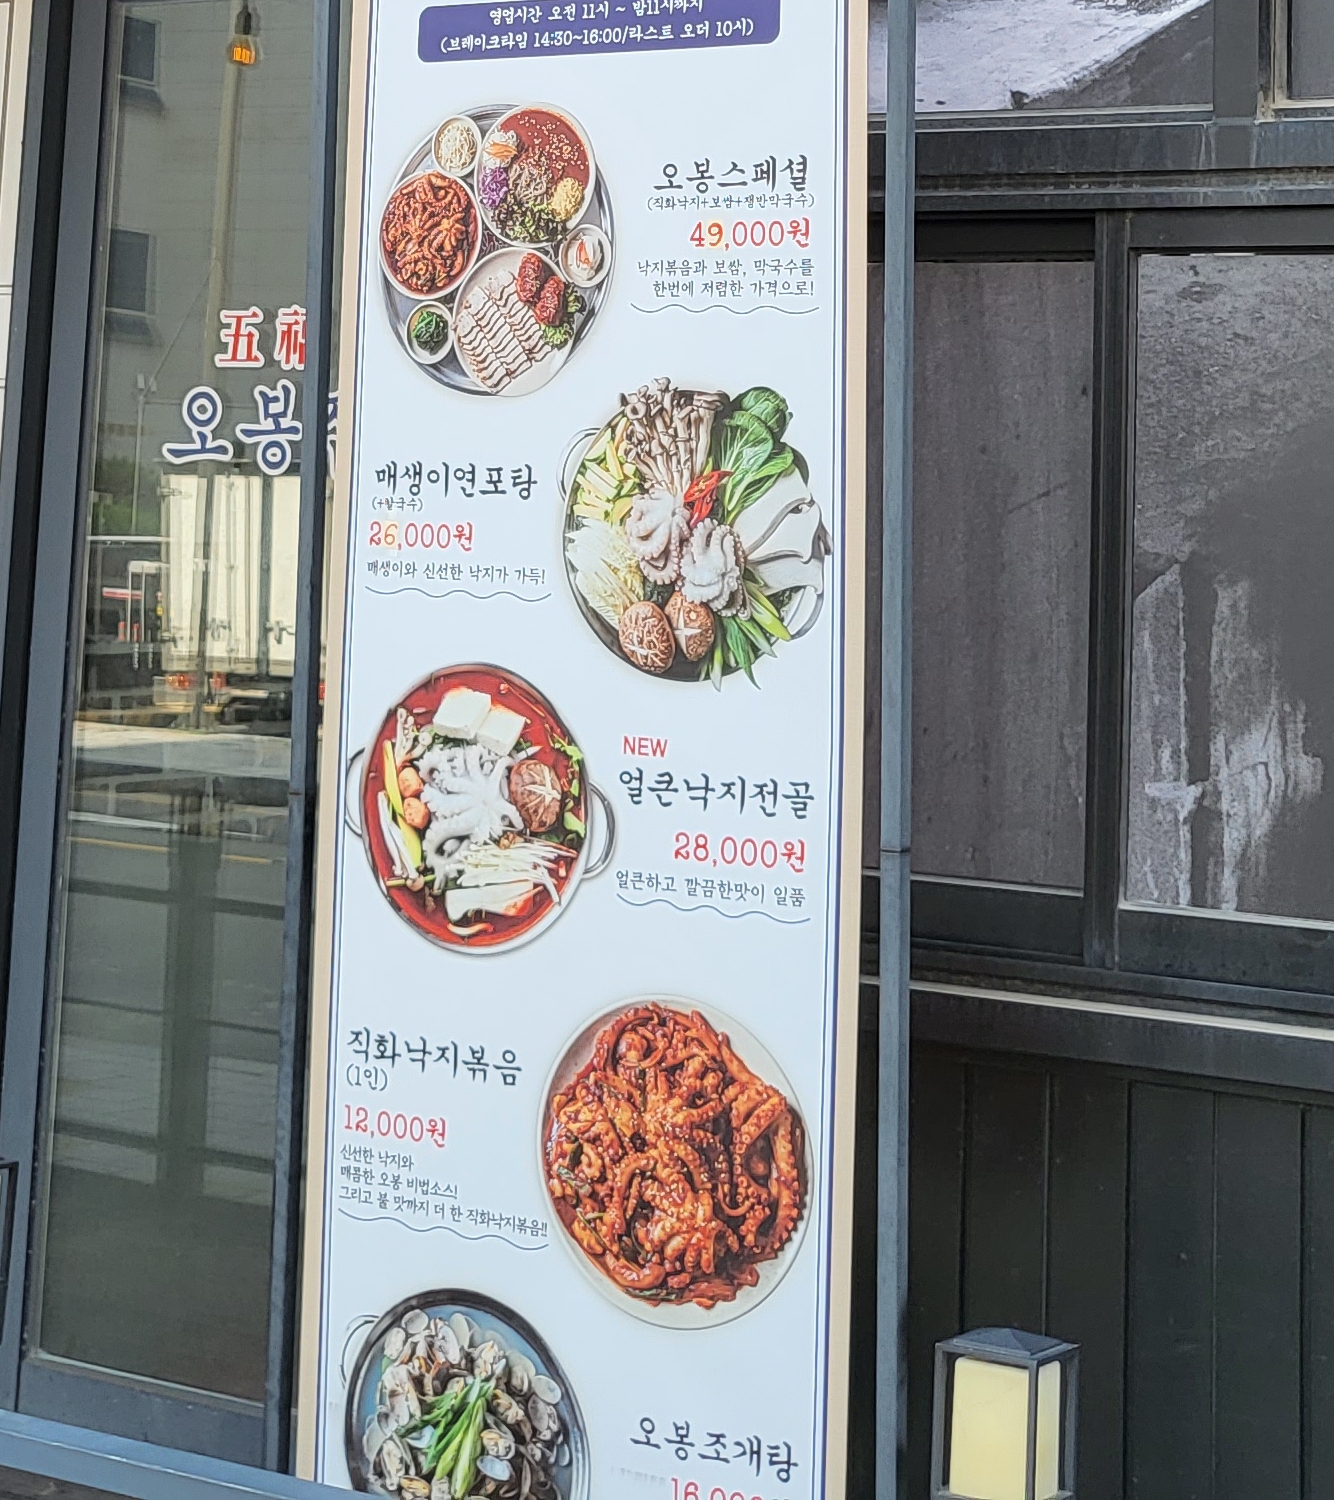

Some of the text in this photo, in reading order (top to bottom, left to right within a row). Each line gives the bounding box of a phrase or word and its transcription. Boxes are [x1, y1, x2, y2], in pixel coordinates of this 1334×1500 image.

[489, 7, 543, 26] 영업시간
[547, 3, 577, 22] 오전
[581, 0, 610, 20] 11시
[440, 29, 528, 54] (브레이크타임
[679, 20, 710, 39] 오더
[715, 17, 755, 38] 10시)
[653, 154, 808, 194] 오봉스페셜
[689, 217, 810, 251] 49,000원
[637, 258, 815, 278] 낙지볶음과 보쌈, 막국수를
[653, 280, 814, 298] 한번에 저렴한 가격으로!
[163, 379, 338, 476] 오봉
[374, 460, 538, 500] 매생이연포탕
[369, 521, 474, 552] 26,000원
[367, 560, 546, 585] 매생이와 신선한 낙지가 가득!
[622, 735, 668, 758] NEW
[619, 766, 815, 820] 얼큰낙지전골
[674, 832, 807, 874] 28,000원
[616, 869, 806, 908] 얼큰하고 깔끔한맛이 일품
[346, 1026, 523, 1087] 직화낙지볶음
[346, 1063, 388, 1092] (1인)
[344, 1104, 447, 1148] 12,000원
[340, 1143, 415, 1172] 신선한 낙지와
[378, 1171, 403, 1190] 오봉
[338, 1186, 548, 1238] 그리고 불 맛까지 더 한 직화낙지볶음!!
[629, 1417, 799, 1483] 오봉조개탕
